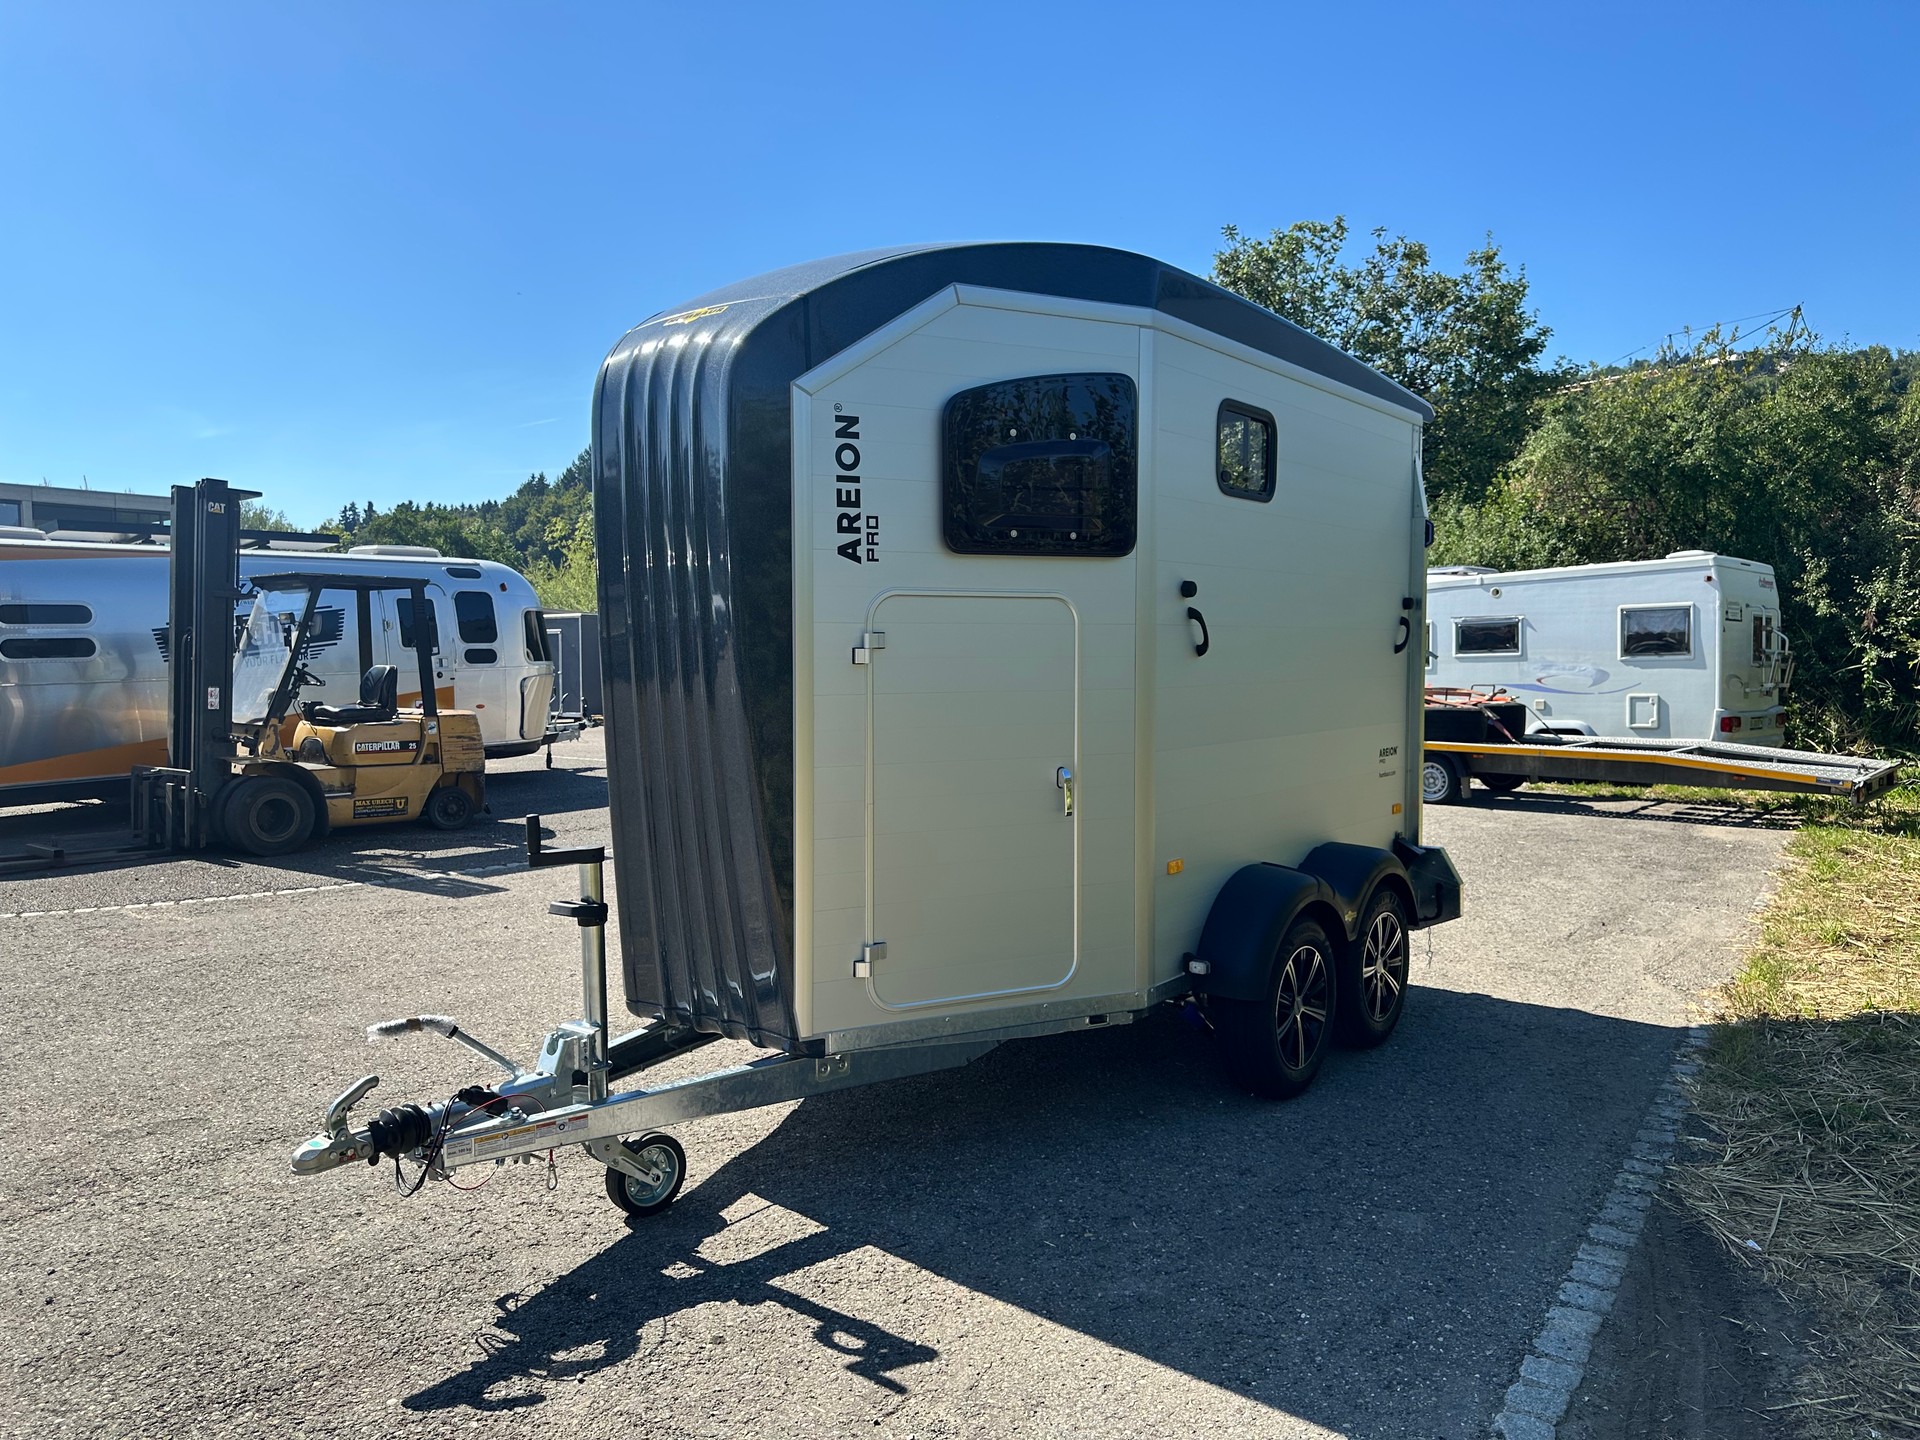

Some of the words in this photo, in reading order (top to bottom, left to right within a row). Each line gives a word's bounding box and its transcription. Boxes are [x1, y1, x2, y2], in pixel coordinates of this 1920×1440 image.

[208, 501, 226, 514] CAT
[866, 515, 880, 562] PRO
[245, 656, 269, 668] YOUR
[356, 741, 400, 752] CATERPILLAR
[409, 742, 417, 750] 25
